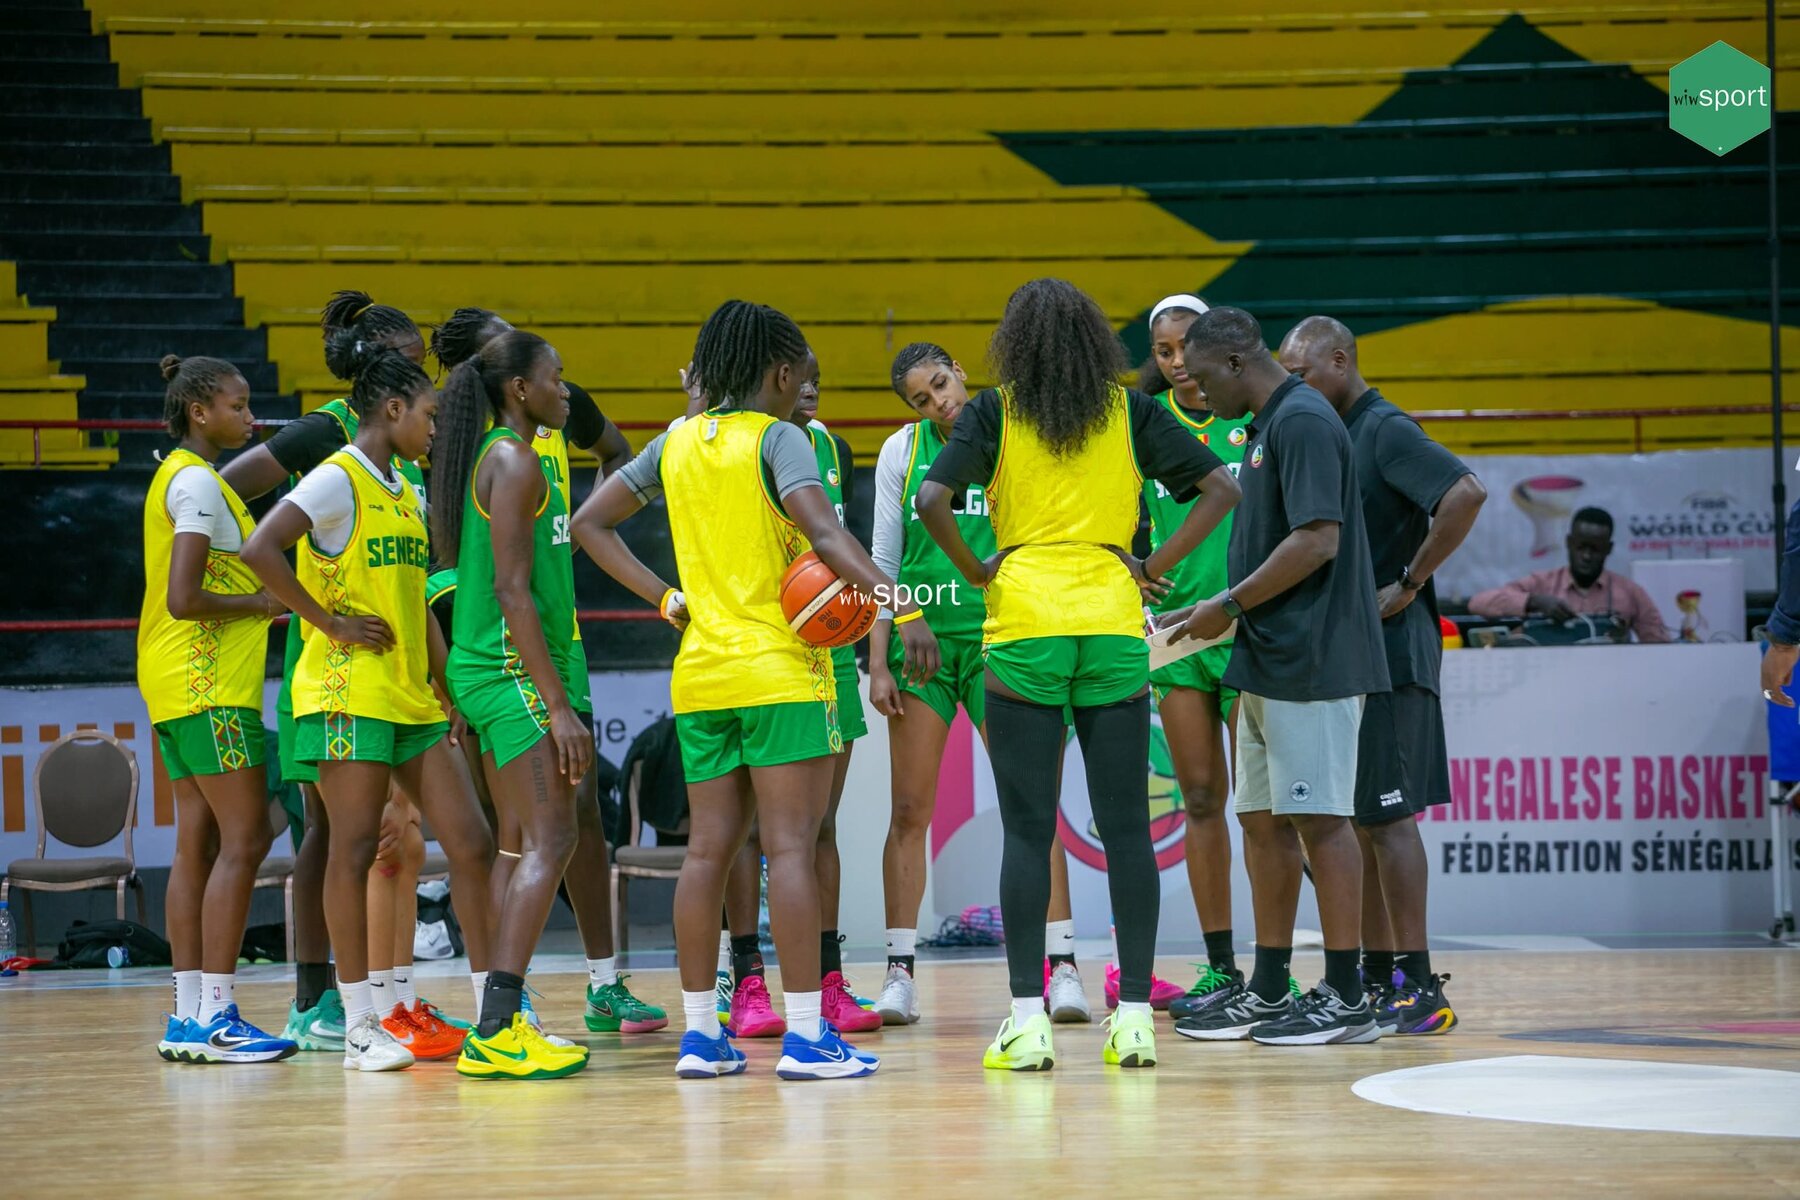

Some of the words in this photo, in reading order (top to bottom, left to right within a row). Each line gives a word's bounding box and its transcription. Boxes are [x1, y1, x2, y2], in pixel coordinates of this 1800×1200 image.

[1629, 522, 1729, 537] WORLD
[1414, 756, 1621, 822] NEGALESE
[1442, 832, 1621, 873] FÉDÉRATION
